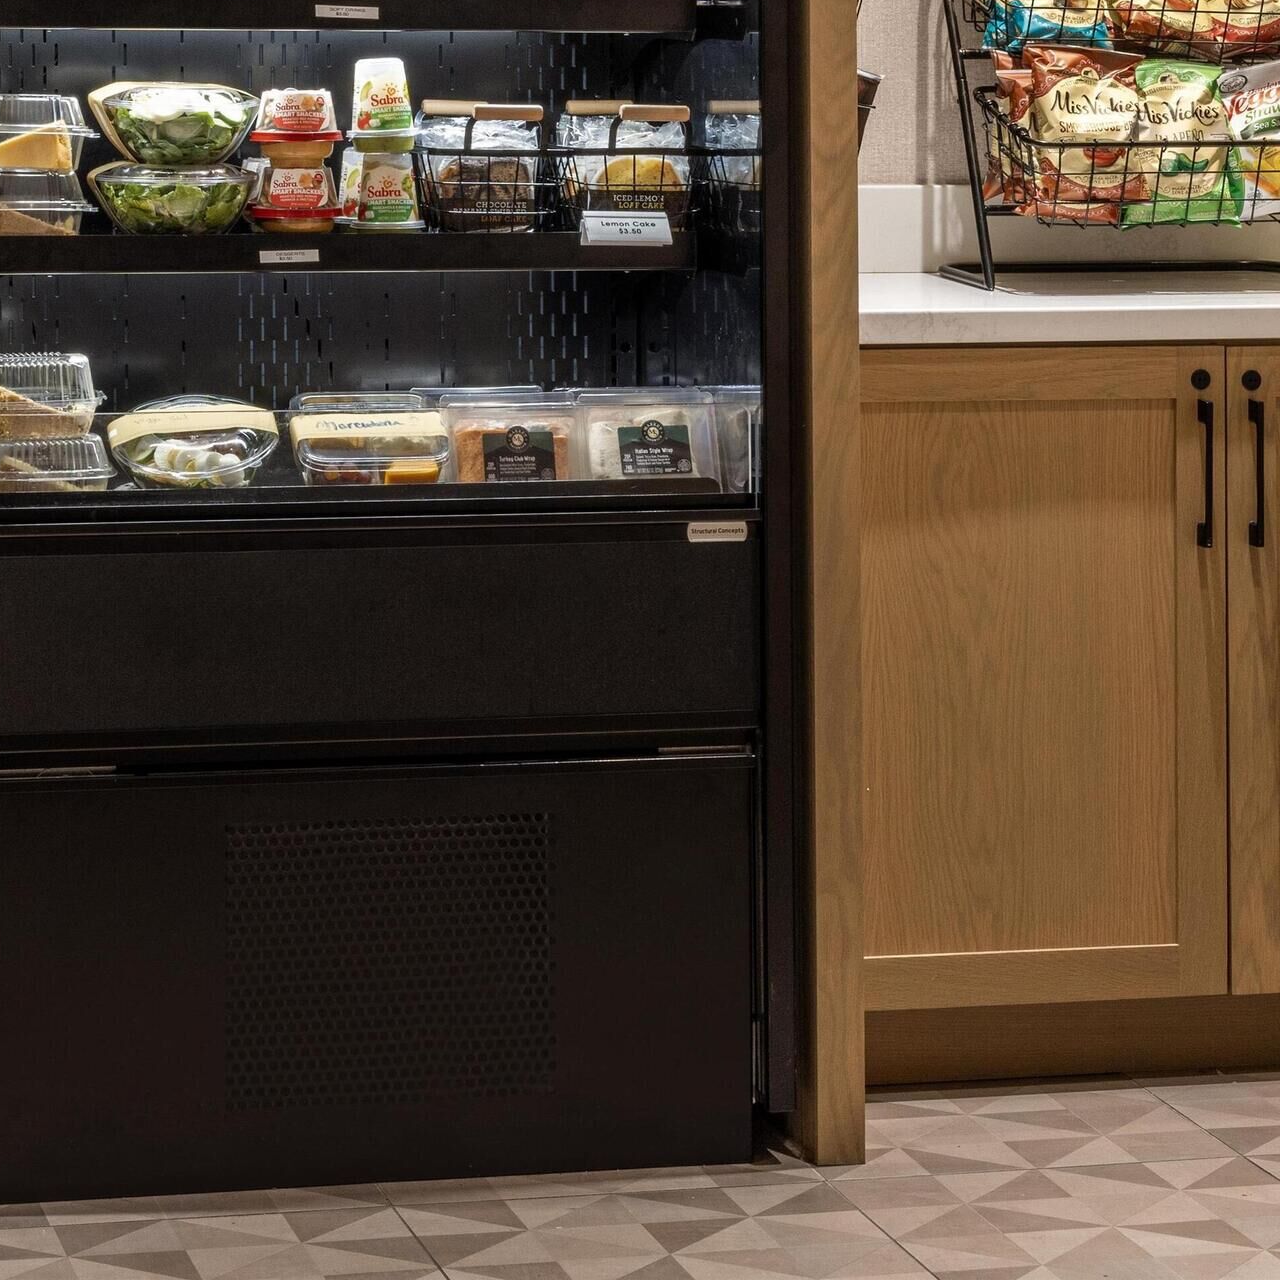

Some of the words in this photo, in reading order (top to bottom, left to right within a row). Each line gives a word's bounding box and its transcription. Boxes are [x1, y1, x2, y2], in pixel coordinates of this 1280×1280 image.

[371, 94, 404, 107] Sabra
[1050, 90, 1089, 115] Miss
[275, 103, 300, 111] Sabra
[1161, 96, 1220, 126] Vickie's
[1254, 120, 1270, 131] Sea
[273, 180, 298, 188] Sabra
[367, 186, 401, 198] Sabra
[613, 194, 632, 202] ICED
[634, 194, 664, 202] LEMON
[475, 201, 527, 209] CHOCOLATE
